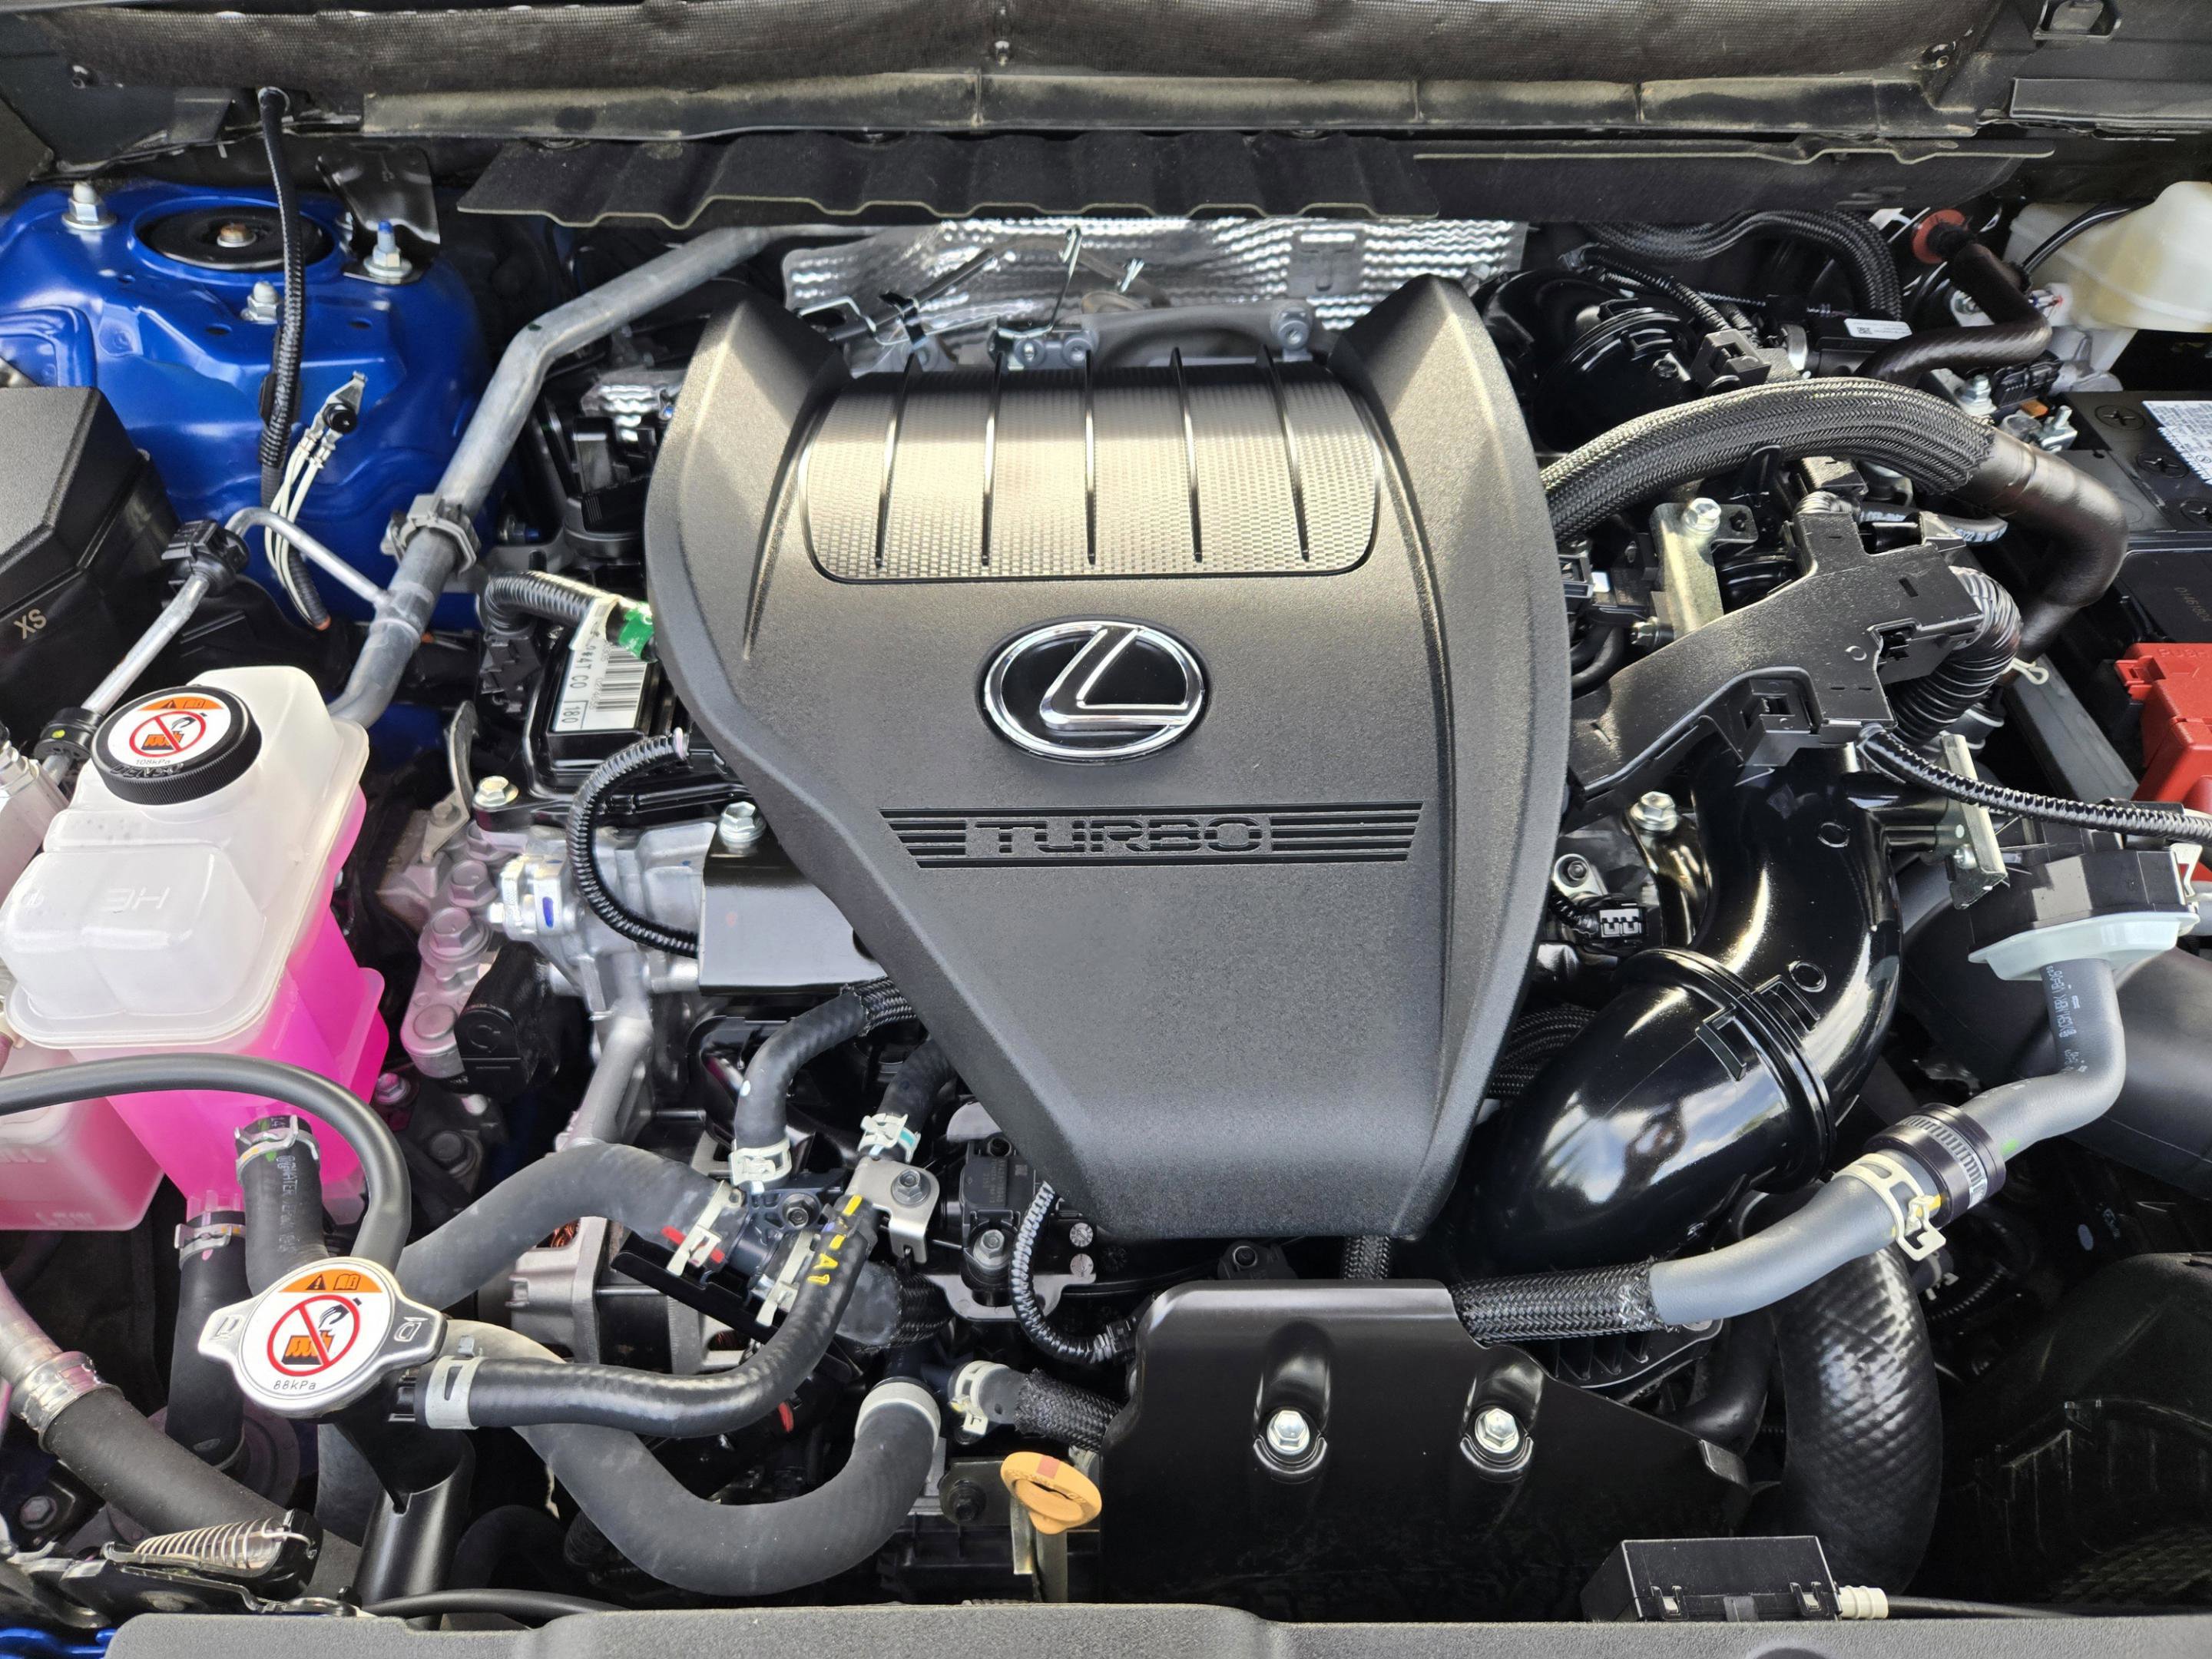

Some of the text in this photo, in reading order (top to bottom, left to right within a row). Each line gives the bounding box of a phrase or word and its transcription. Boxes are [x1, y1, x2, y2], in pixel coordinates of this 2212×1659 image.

[13, 609, 47, 640] XS
[561, 705, 581, 724] 180
[975, 817, 1263, 854] TURBO
[273, 1379, 316, 1390] 88kPa
